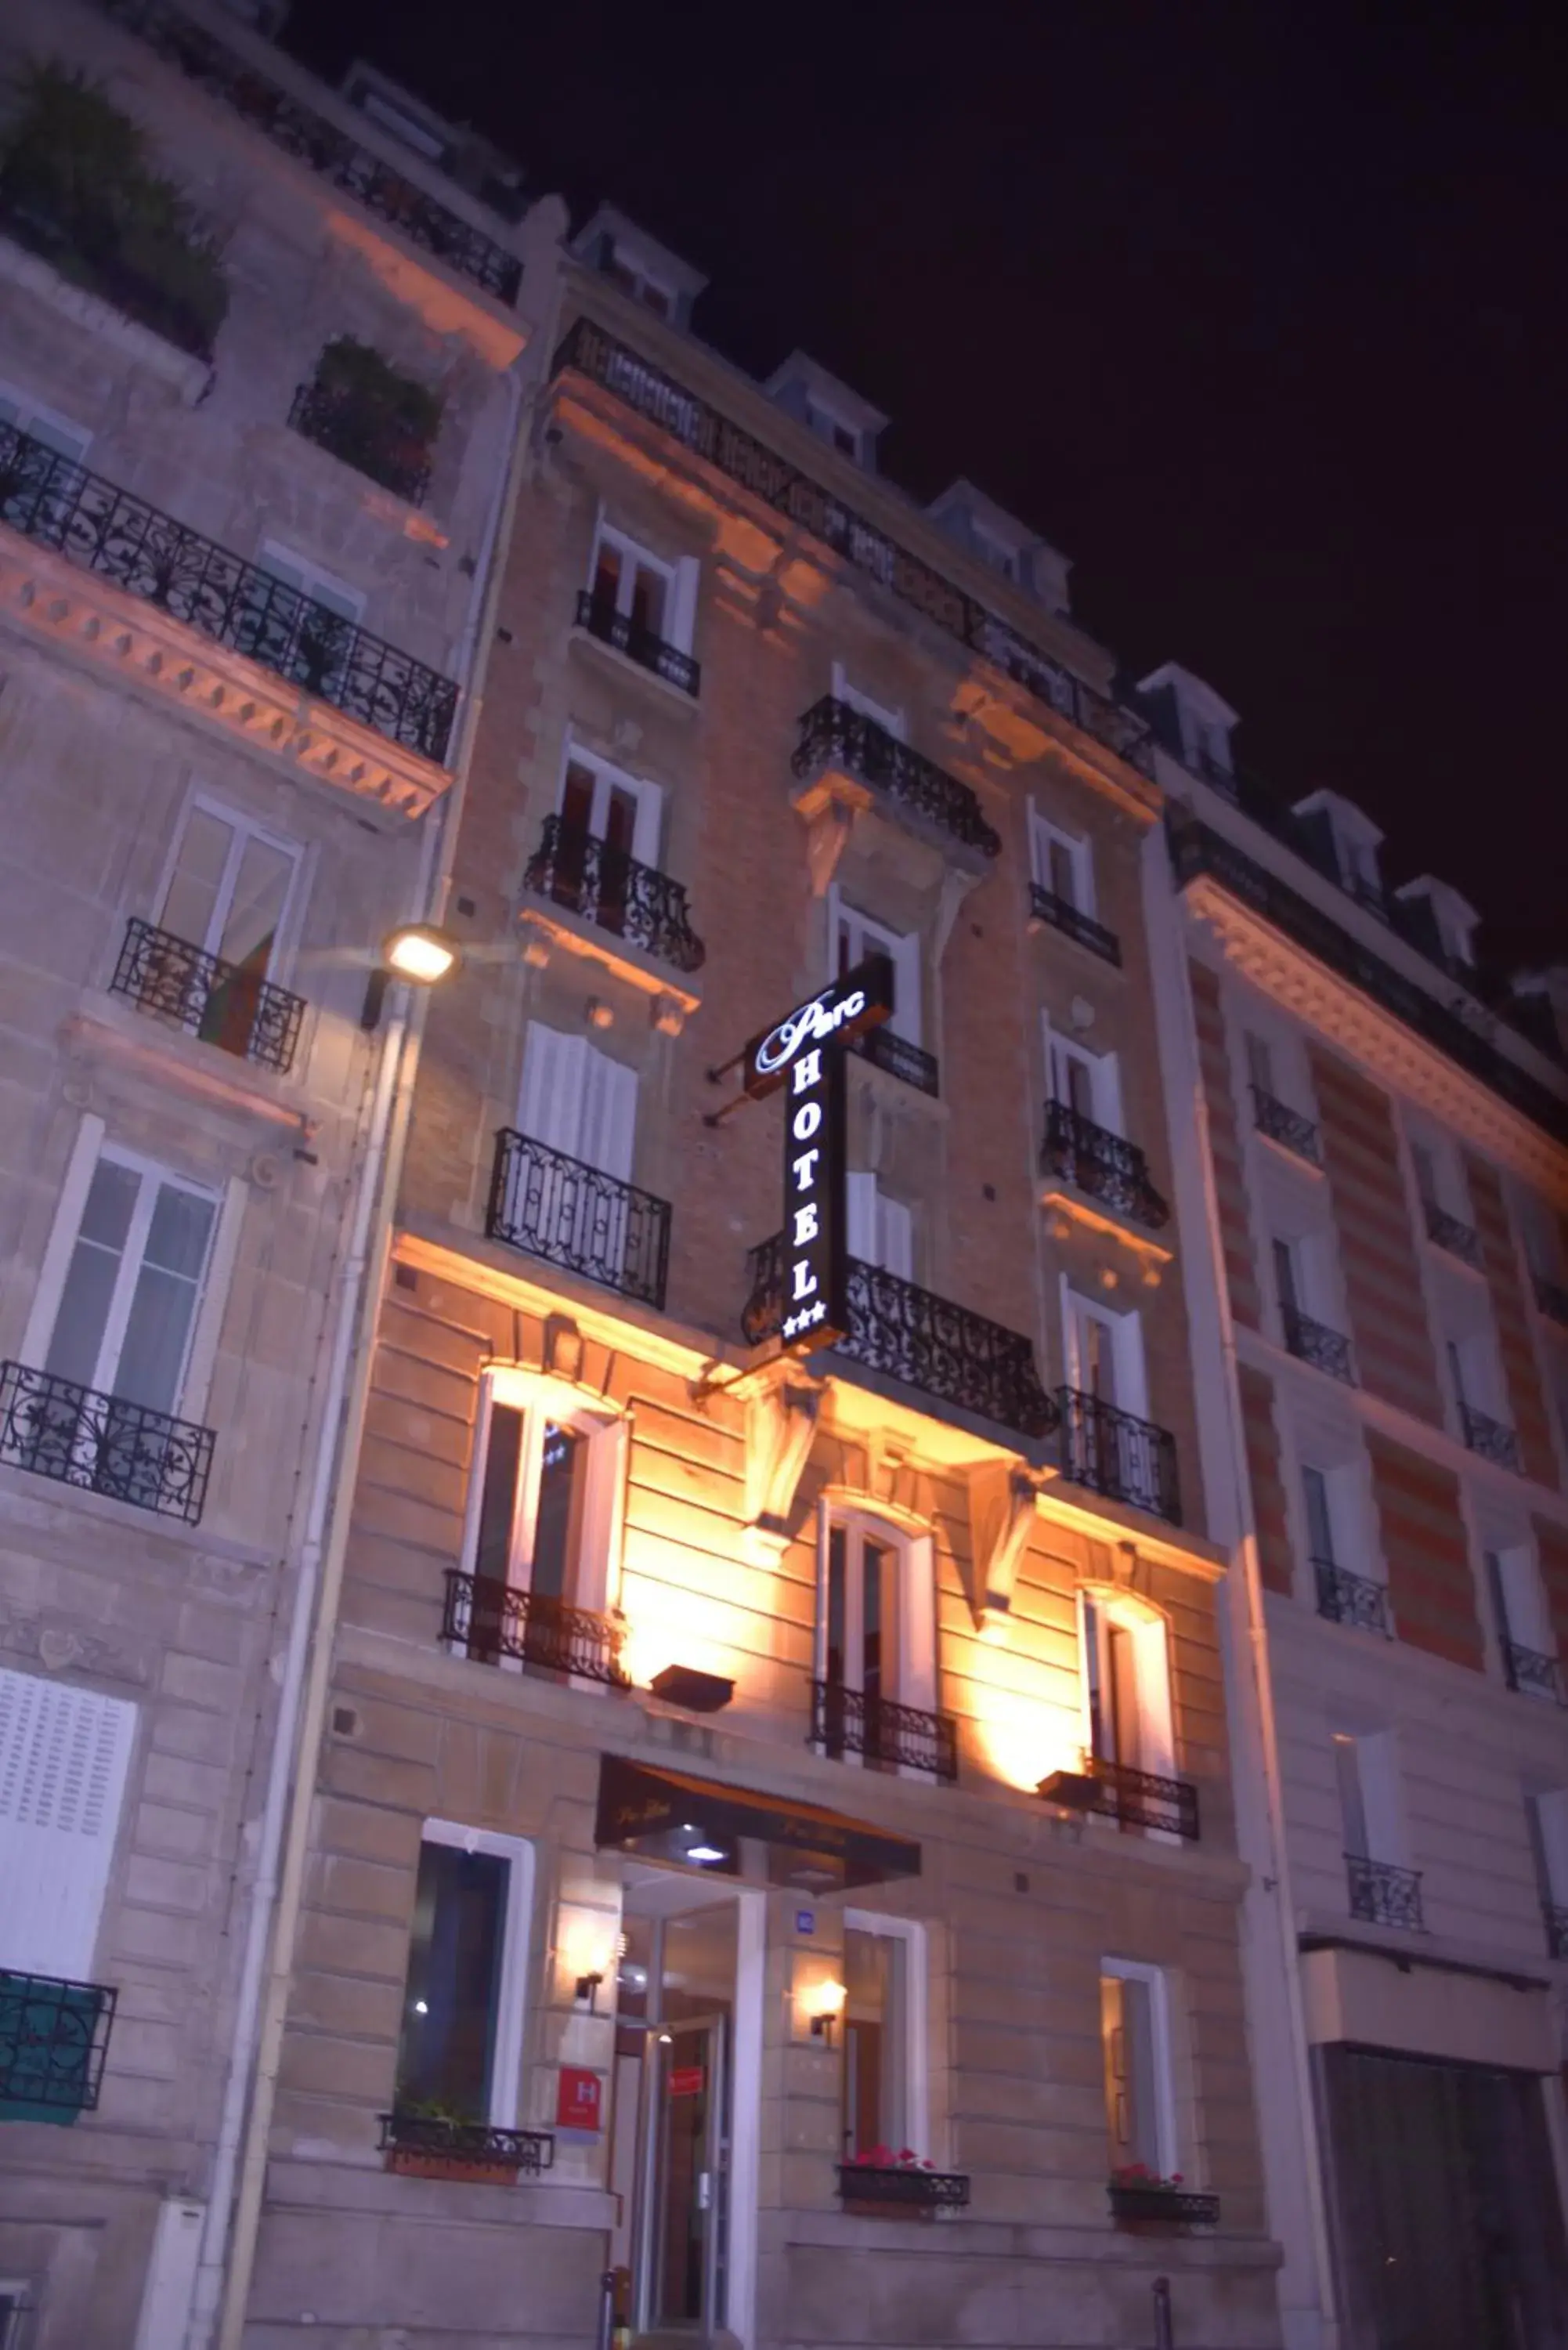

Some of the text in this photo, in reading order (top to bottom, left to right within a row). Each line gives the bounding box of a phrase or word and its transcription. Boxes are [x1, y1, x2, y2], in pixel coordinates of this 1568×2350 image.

[755, 990, 865, 1073] Parc
[792, 1048, 822, 1301] HOTEL
[577, 2081, 597, 2103] H
